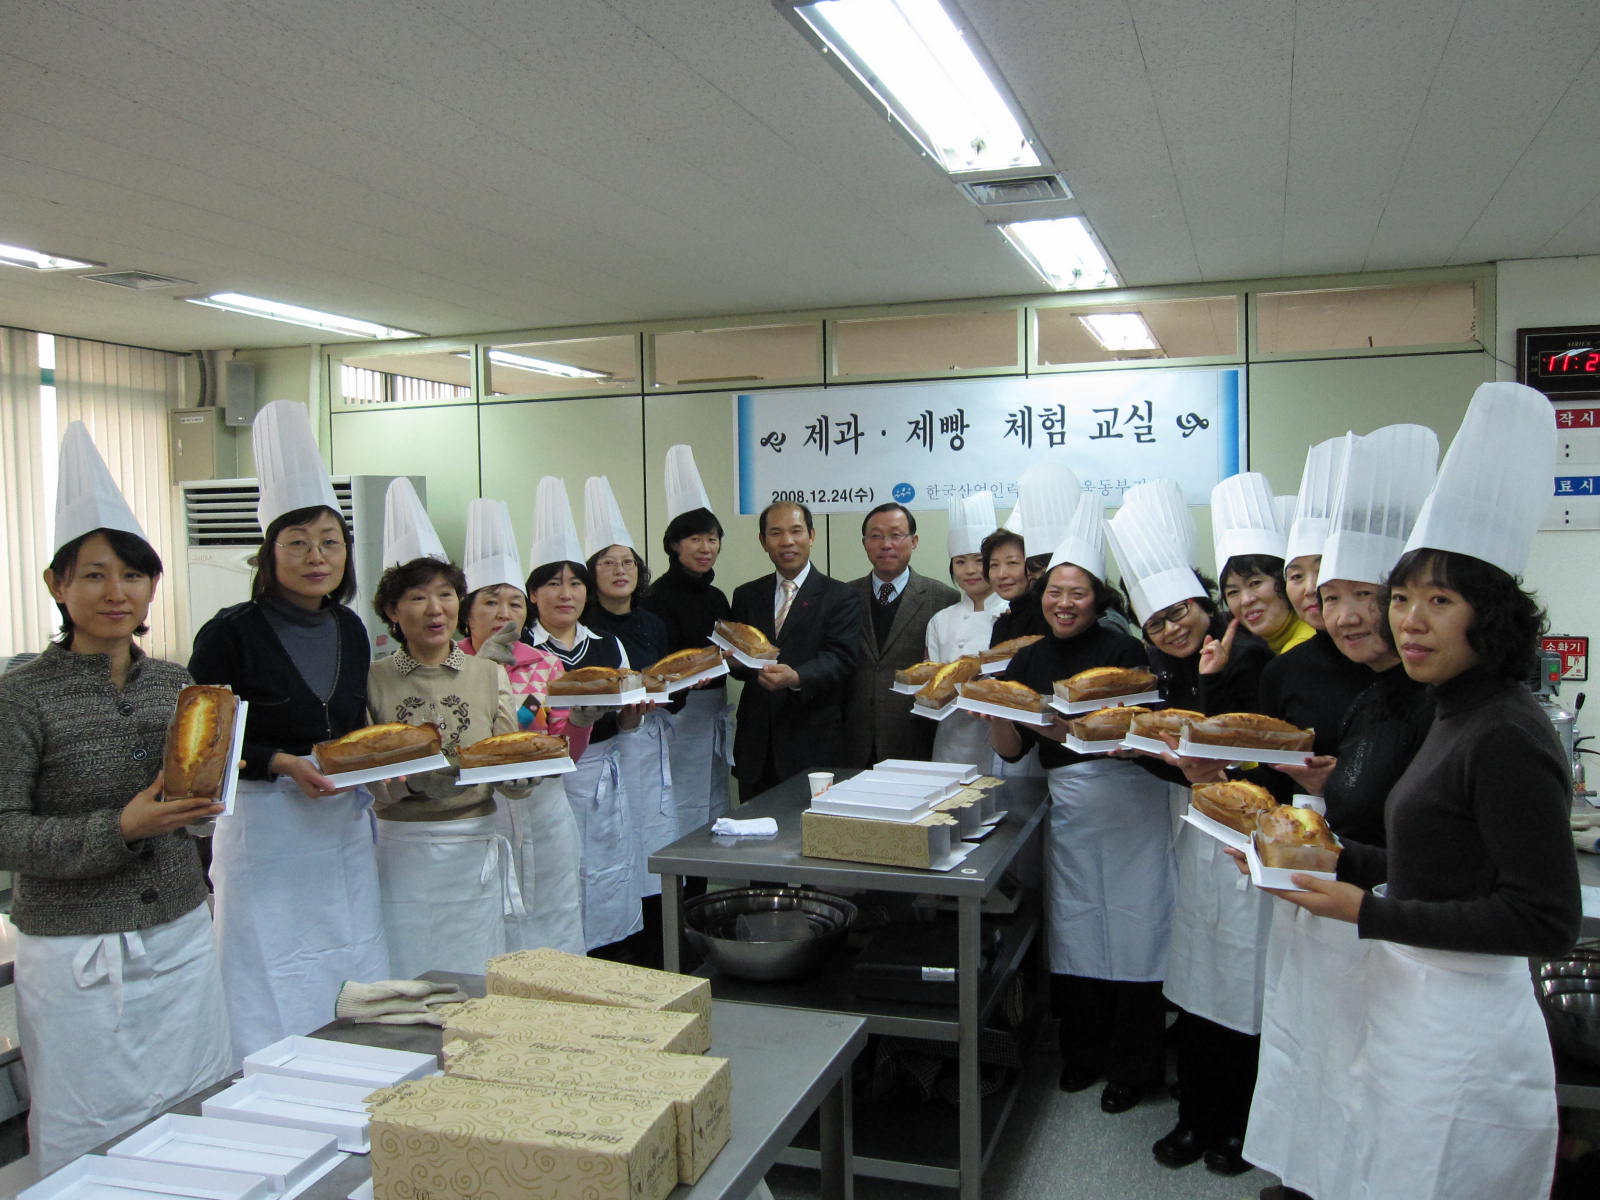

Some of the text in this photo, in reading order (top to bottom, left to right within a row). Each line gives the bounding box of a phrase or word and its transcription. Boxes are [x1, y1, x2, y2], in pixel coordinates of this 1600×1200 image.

[1549, 353, 1600, 372] 11:2
[1559, 411, 1594, 427] 작시
[803, 413, 865, 456] 제과
[906, 408, 970, 452] 제빵
[1002, 403, 1068, 449] 체험
[1089, 400, 1157, 444] 교실
[926, 482, 1019, 500] 한국산업인력
[1558, 478, 1593, 494] 료시
[772, 487, 874, 503] 2008.12.24(수)
[1545, 642, 1581, 652] 소화기
[545, 1129, 623, 1144] Roll Cake
